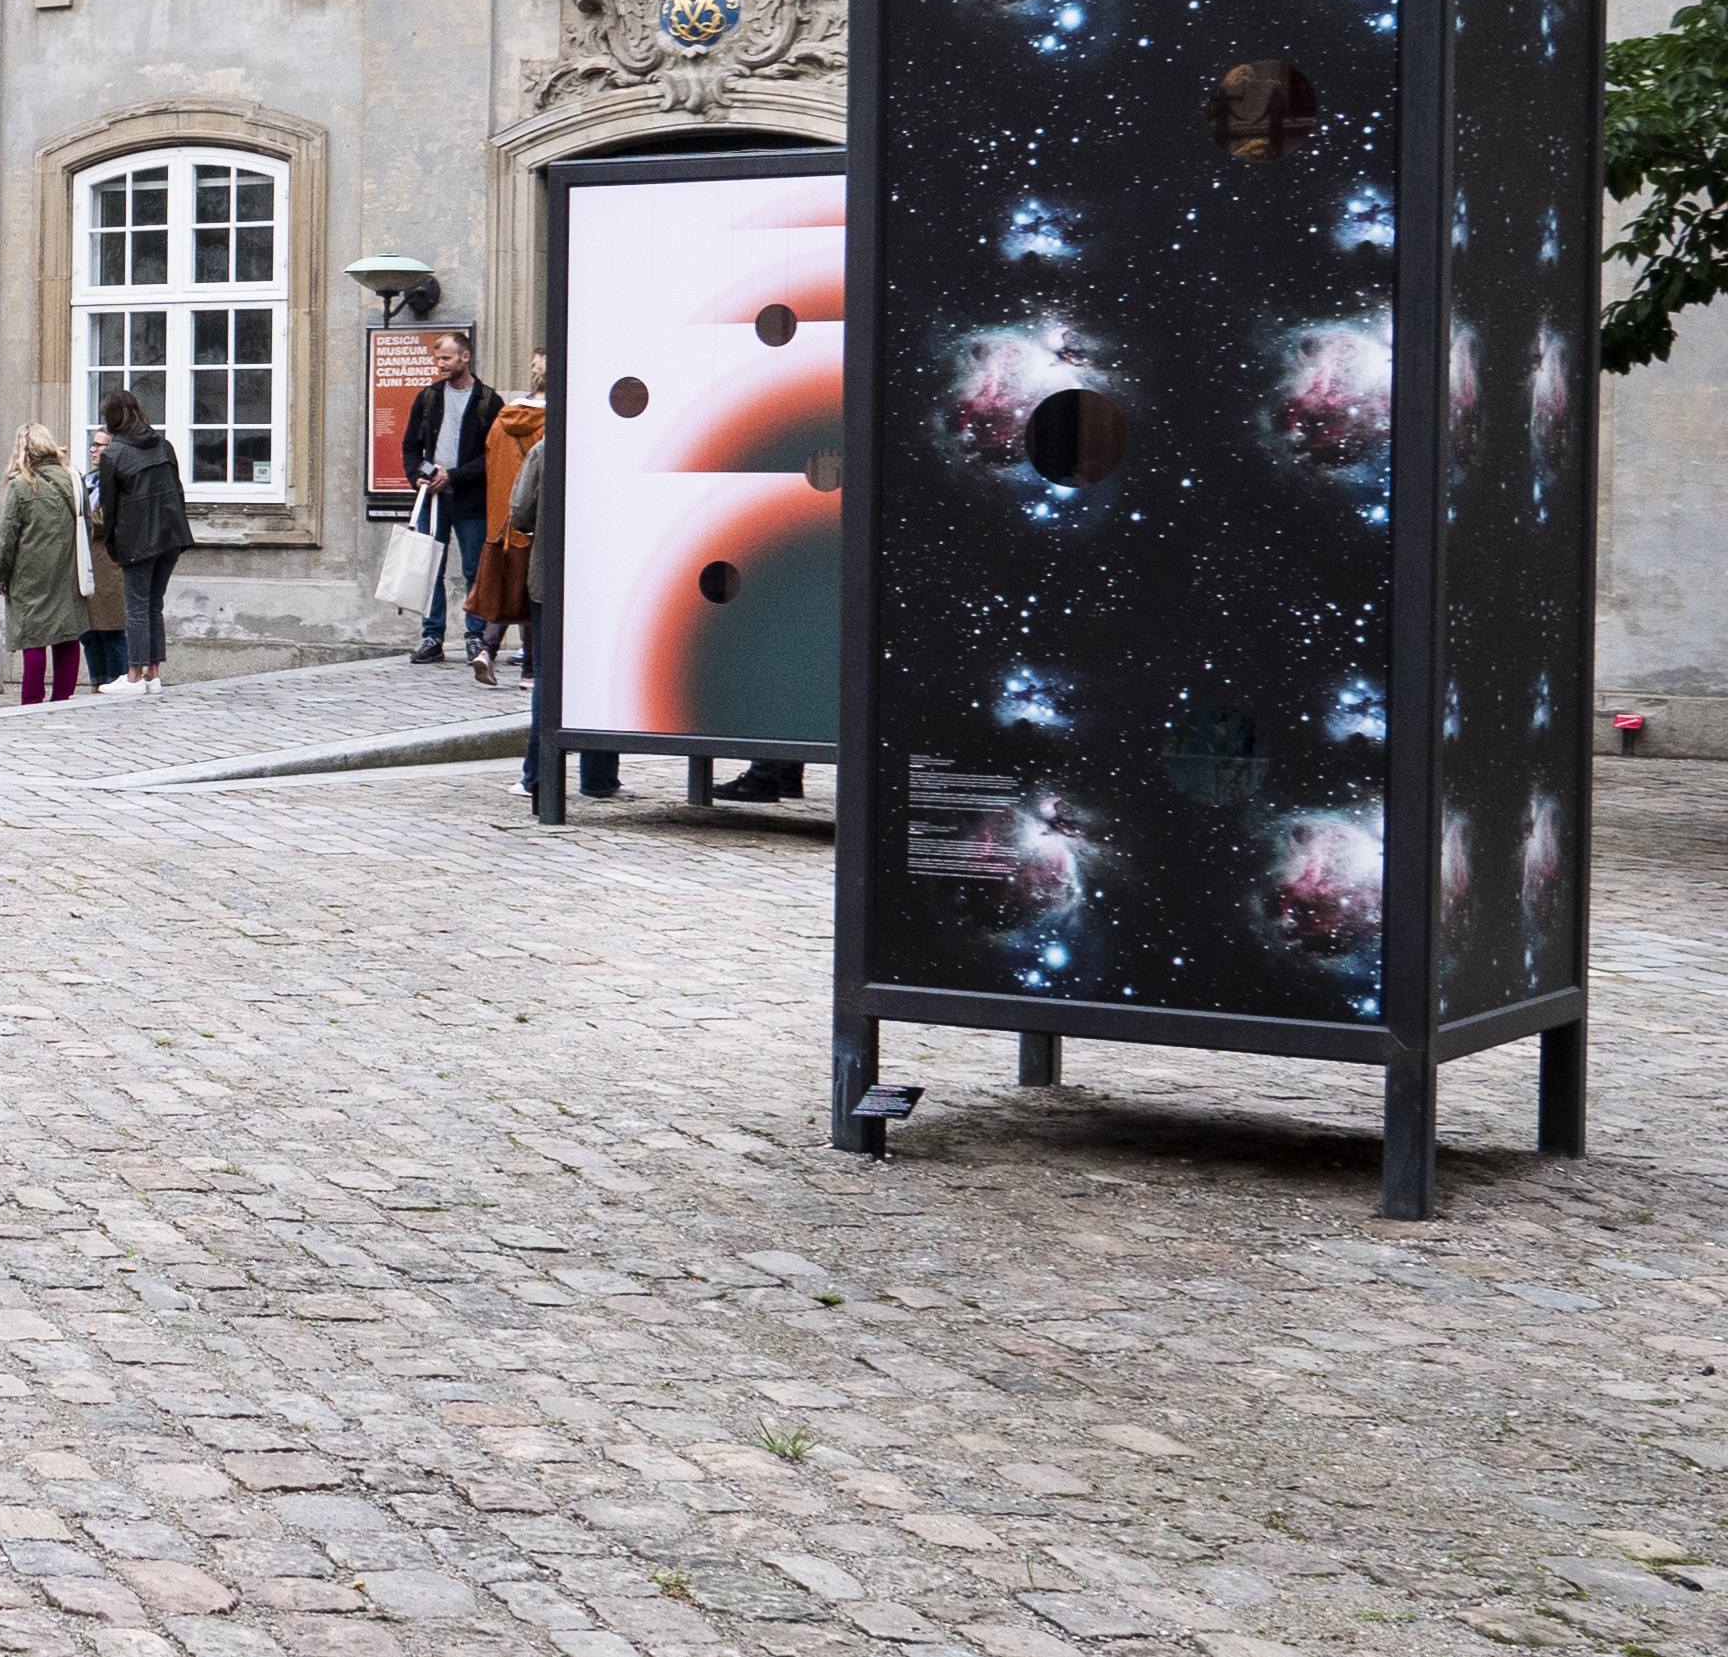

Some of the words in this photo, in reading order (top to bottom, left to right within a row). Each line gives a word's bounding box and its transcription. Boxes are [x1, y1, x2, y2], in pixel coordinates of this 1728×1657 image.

[375, 335, 420, 345] DESIGN
[375, 345, 428, 356] MUSEUM
[375, 356, 435, 366] DANMARK
[375, 378, 403, 388] JUNI
[404, 377, 433, 387] 2022
